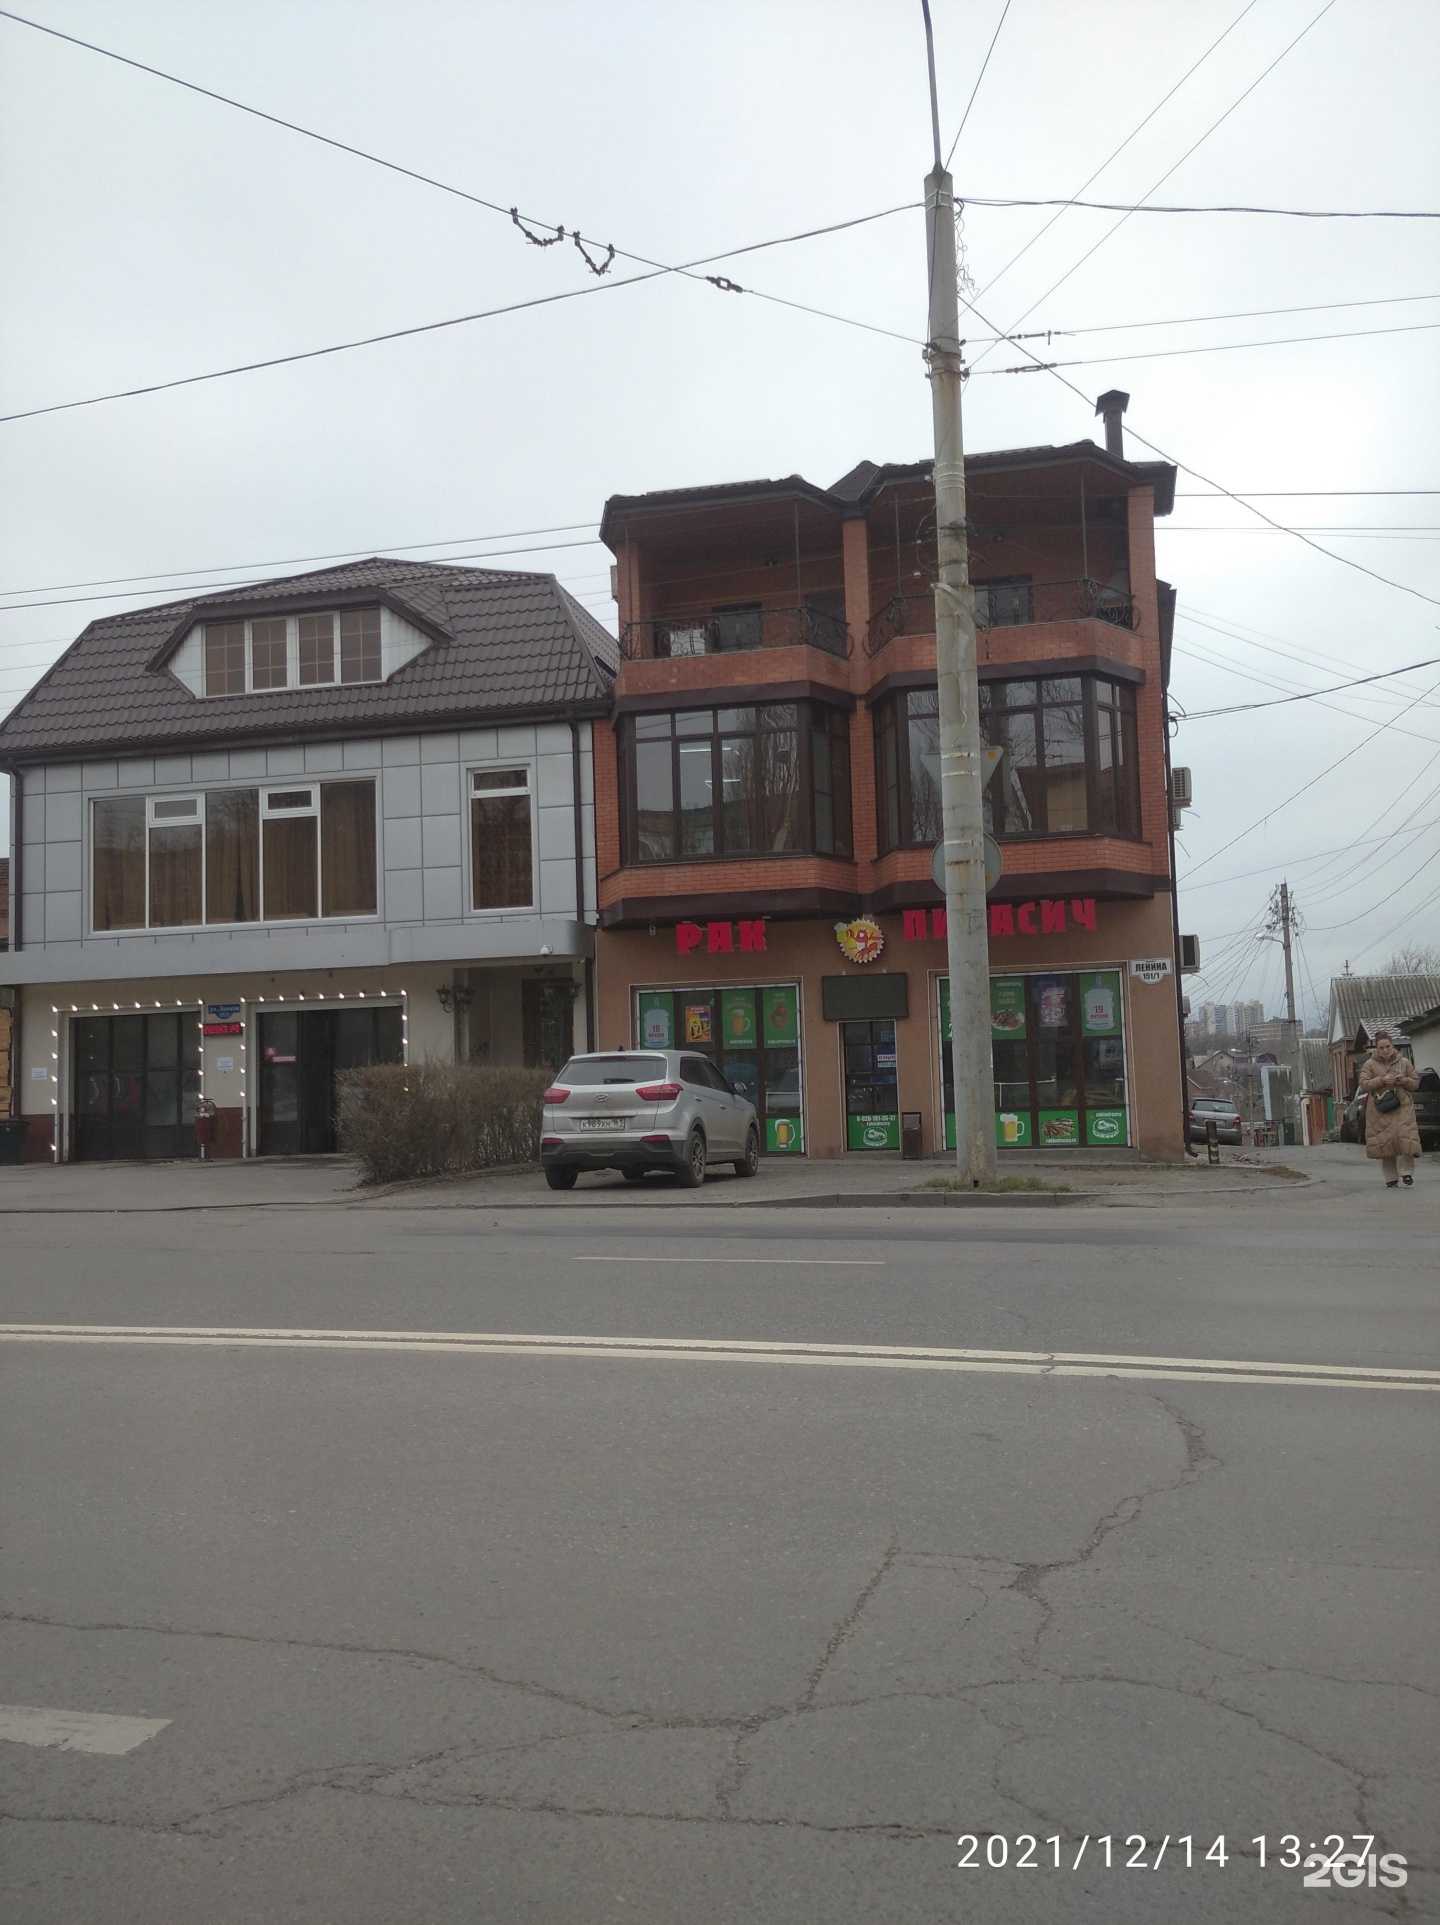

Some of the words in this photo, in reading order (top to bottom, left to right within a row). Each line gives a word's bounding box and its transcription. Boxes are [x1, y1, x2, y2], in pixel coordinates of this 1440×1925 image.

[675, 919, 767, 954] РАК
[903, 898, 1097, 941] ПИАСИЧ
[1136, 963, 1167, 971] ЛЕНИНА
